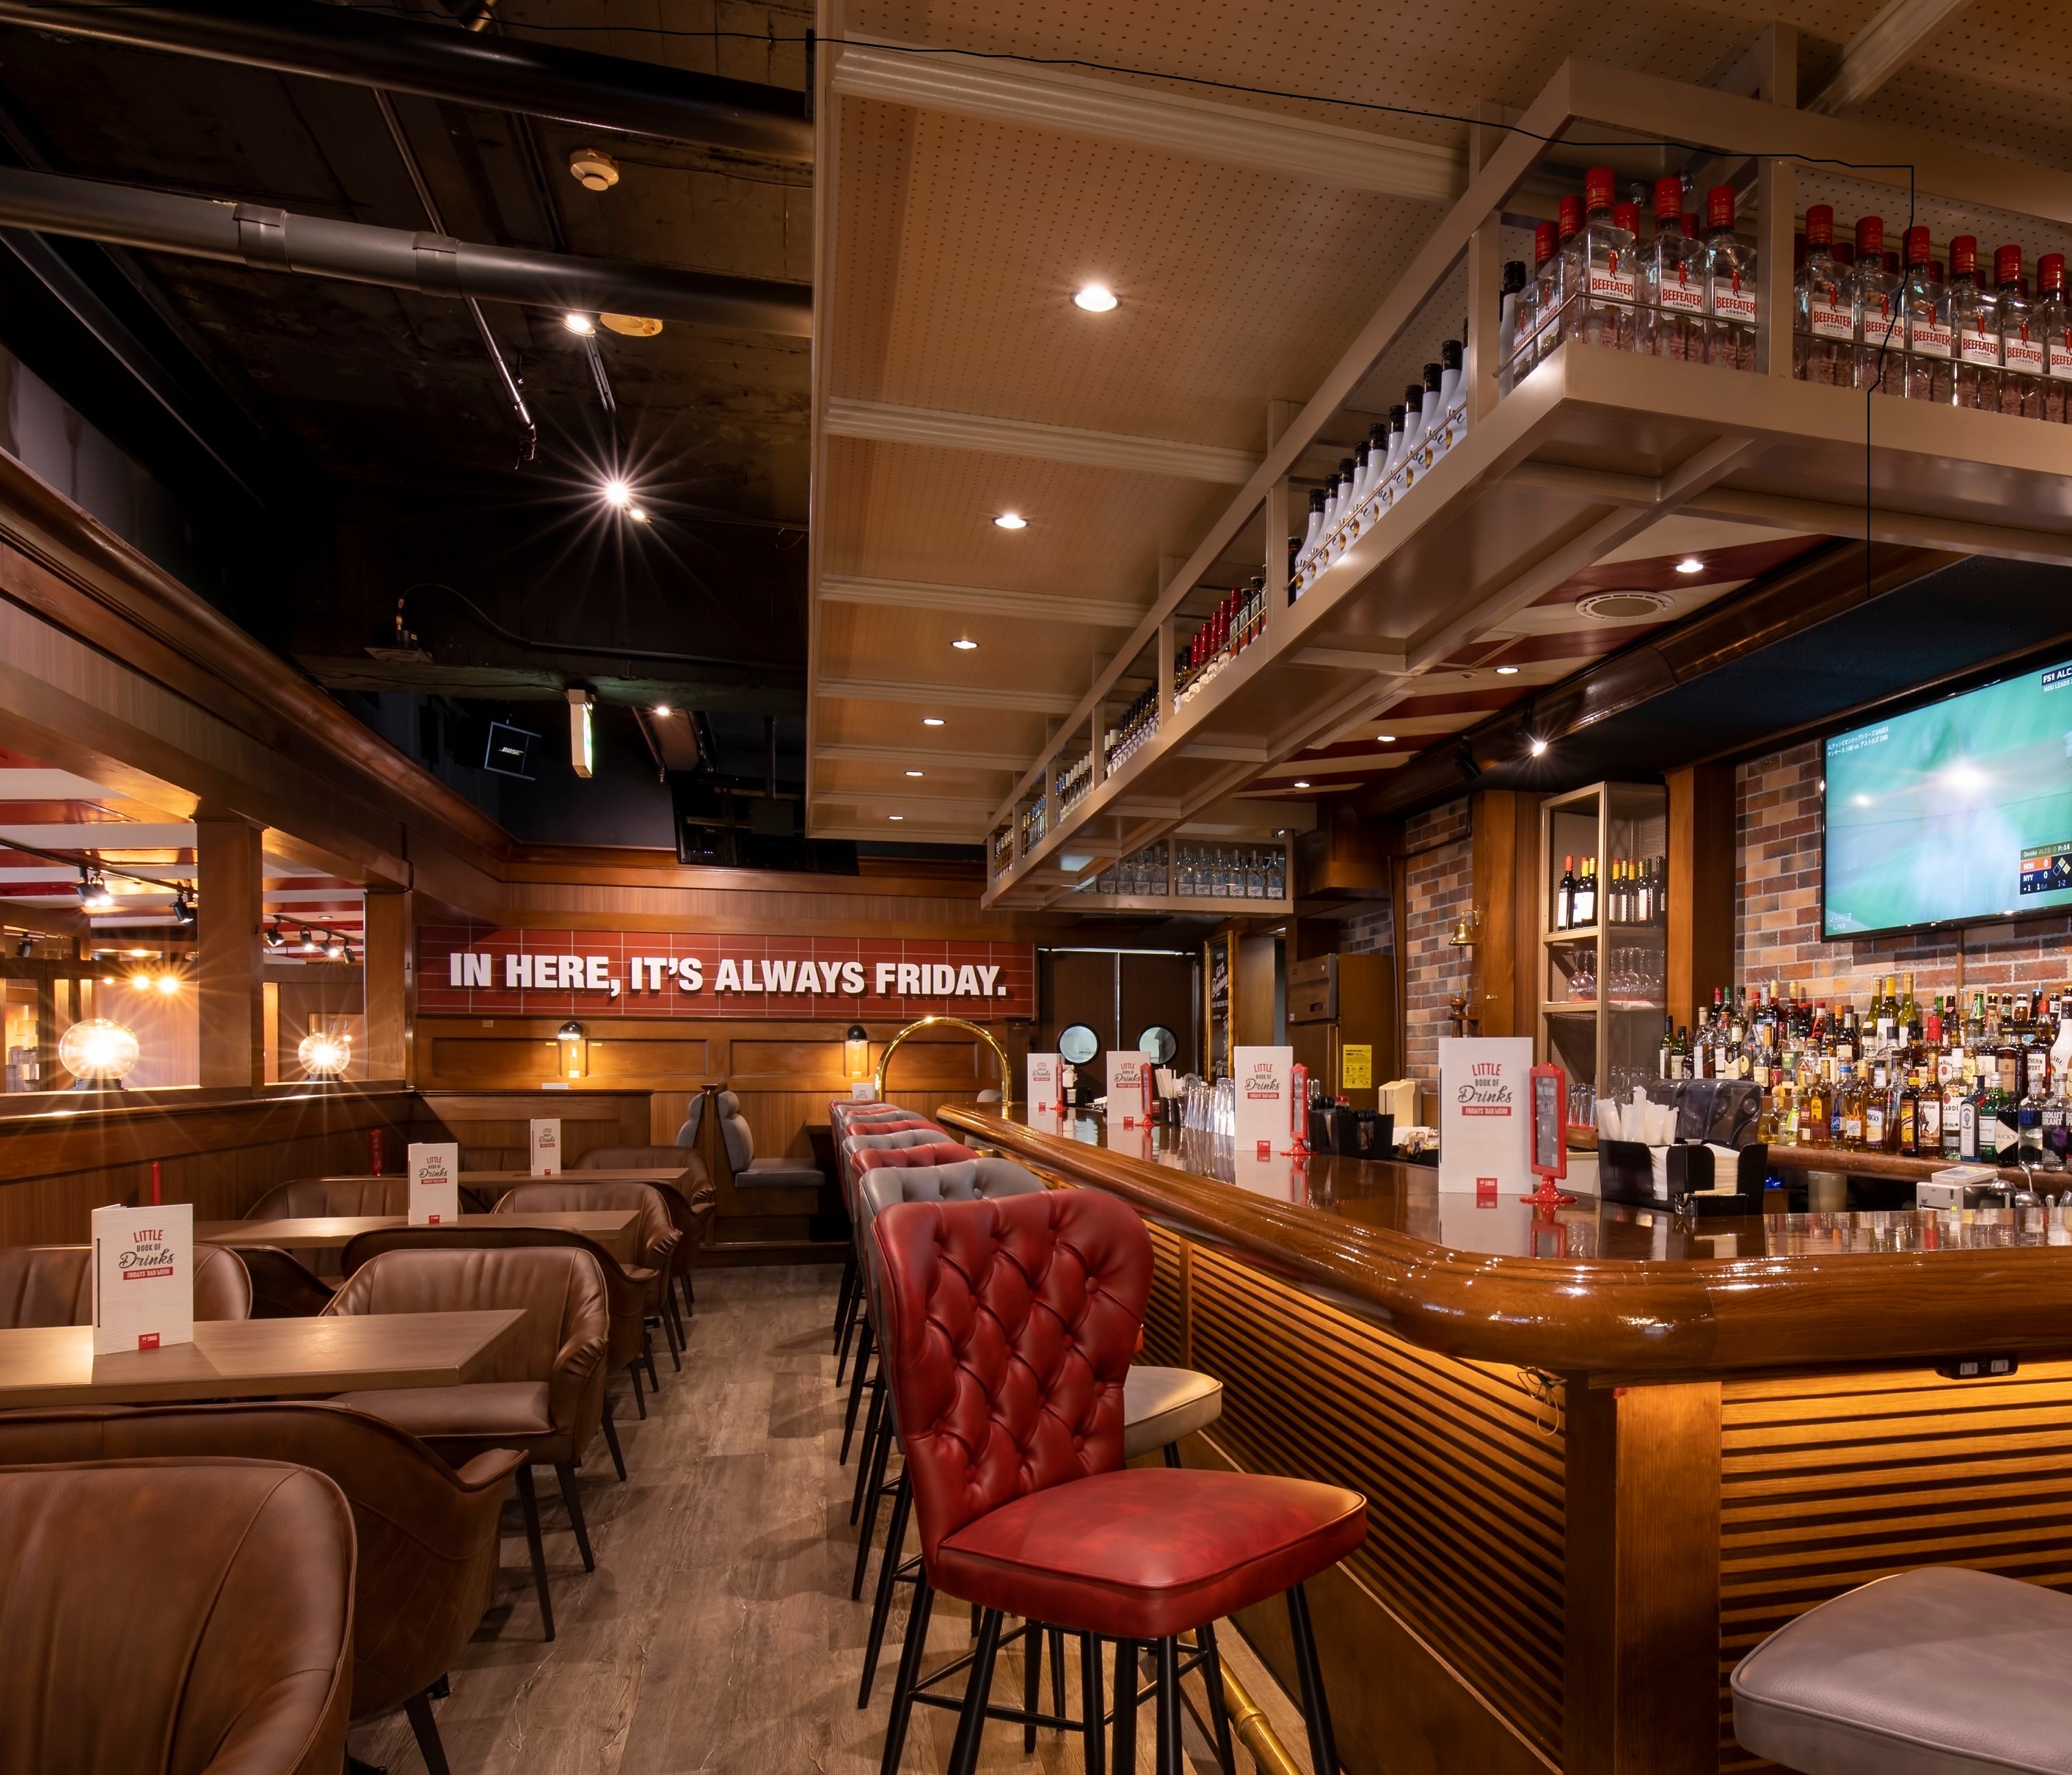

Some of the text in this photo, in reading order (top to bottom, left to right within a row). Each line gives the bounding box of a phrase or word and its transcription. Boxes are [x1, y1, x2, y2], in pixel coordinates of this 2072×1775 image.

[1592, 278, 1633, 297] BEEFEATER
[1662, 289, 1702, 308] BEEFEATER
[1716, 296, 1756, 315] BEEFEATER
[1814, 311, 1852, 329] BEEFEATER
[1866, 321, 1903, 338] BEEFEATER
[1914, 331, 1950, 347] BEEFEATER
[1963, 338, 1998, 355] BEEFEATER
[2007, 347, 2042, 364] BEEFEATER
[2043, 667, 2072, 683] FS1 ALC
[2044, 679, 2070, 692] HOU LEADS
[499, 747, 523, 756] BOSE
[2043, 859, 2049, 867] 0
[2043, 871, 2048, 879] 0
[450, 953, 491, 986] IN
[506, 954, 620, 997] HERE,
[714, 959, 865, 994] ALWAYS
[876, 962, 1007, 996] FRIDAY.
[1253, 1063, 1273, 1073] LITTLE
[1472, 1063, 1502, 1076] LITTLE
[1114, 1073, 1140, 1082] Drinks
[1245, 1078, 1280, 1091] Drinks
[1458, 1085, 1513, 1103] Drinks
[419, 1167, 448, 1179] Drinks
[133, 1229, 163, 1243] LITTLE
[136, 1244, 153, 1252] BOOK
[118, 1248, 174, 1269] Drinks
